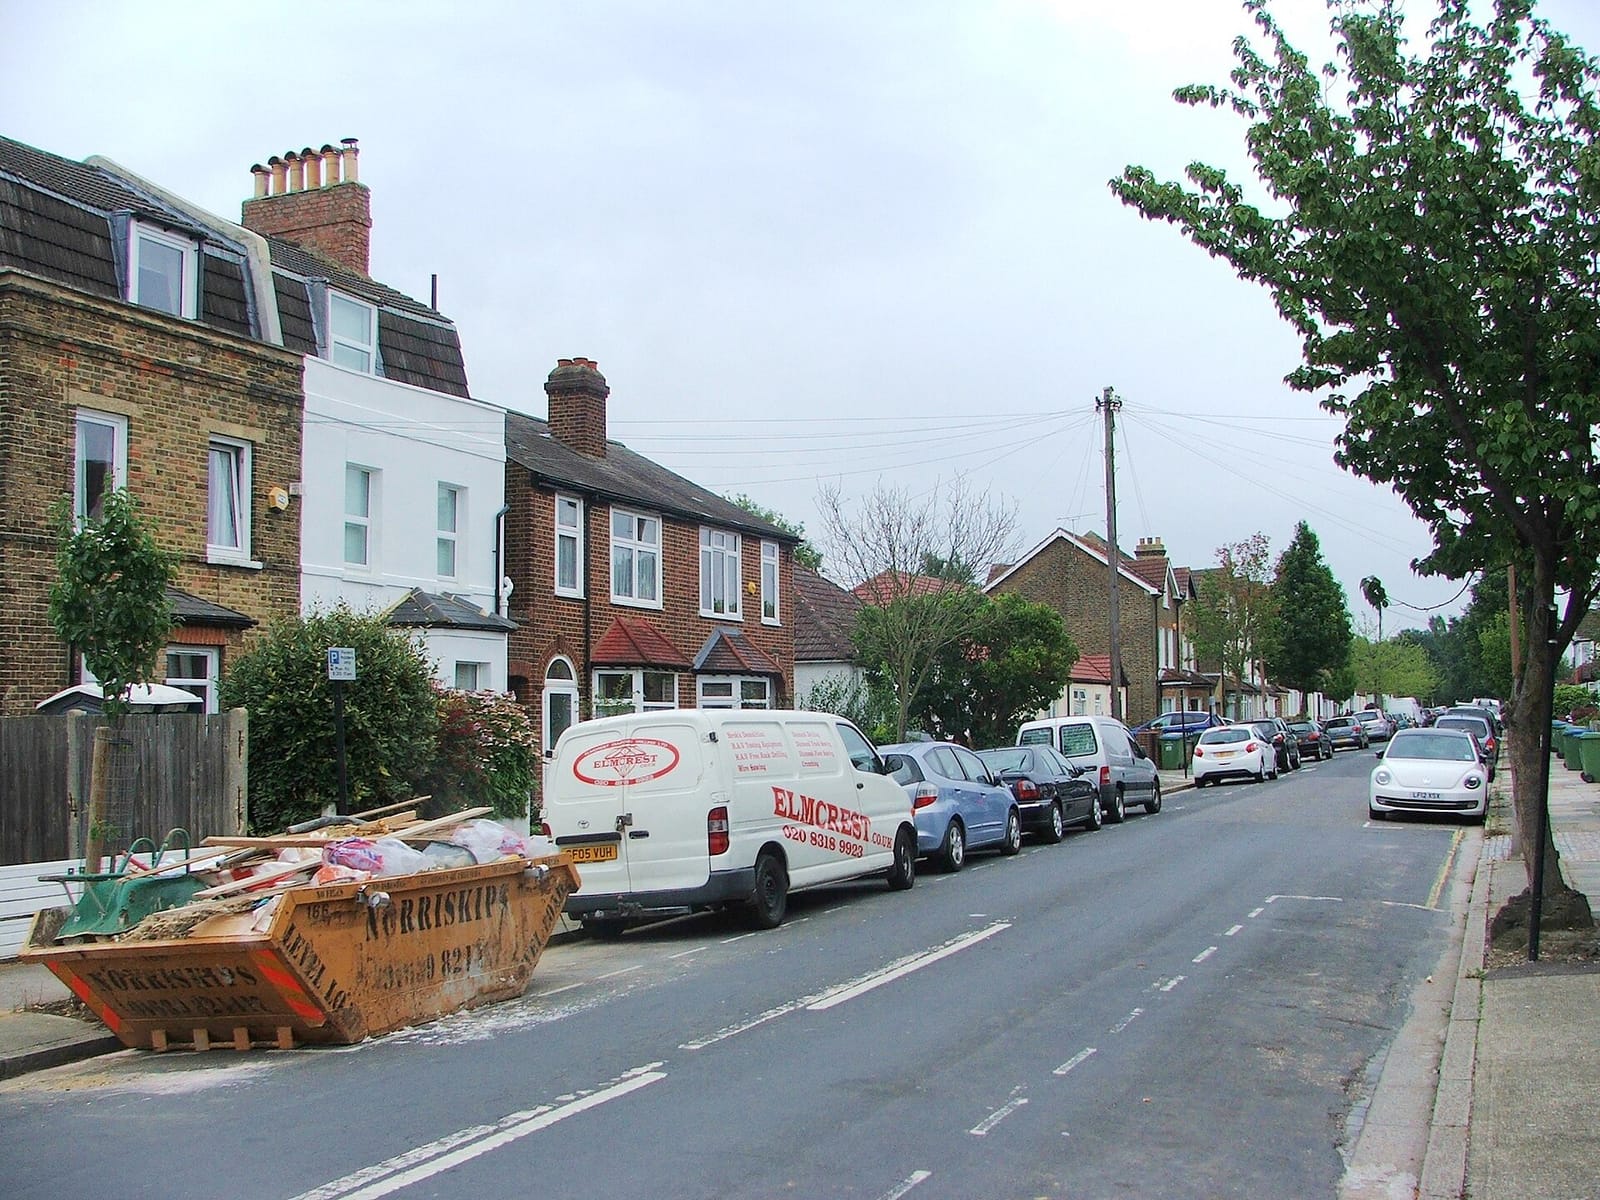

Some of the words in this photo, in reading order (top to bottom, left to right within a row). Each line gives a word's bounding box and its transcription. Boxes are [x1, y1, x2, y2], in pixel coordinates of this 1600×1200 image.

[593, 755, 658, 769] ELMCREST
[772, 786, 871, 842] ELMCREST
[593, 846, 612, 859] VUH
[782, 824, 807, 843] 020
[810, 831, 836, 851] 8318
[839, 839, 864, 858] 9923
